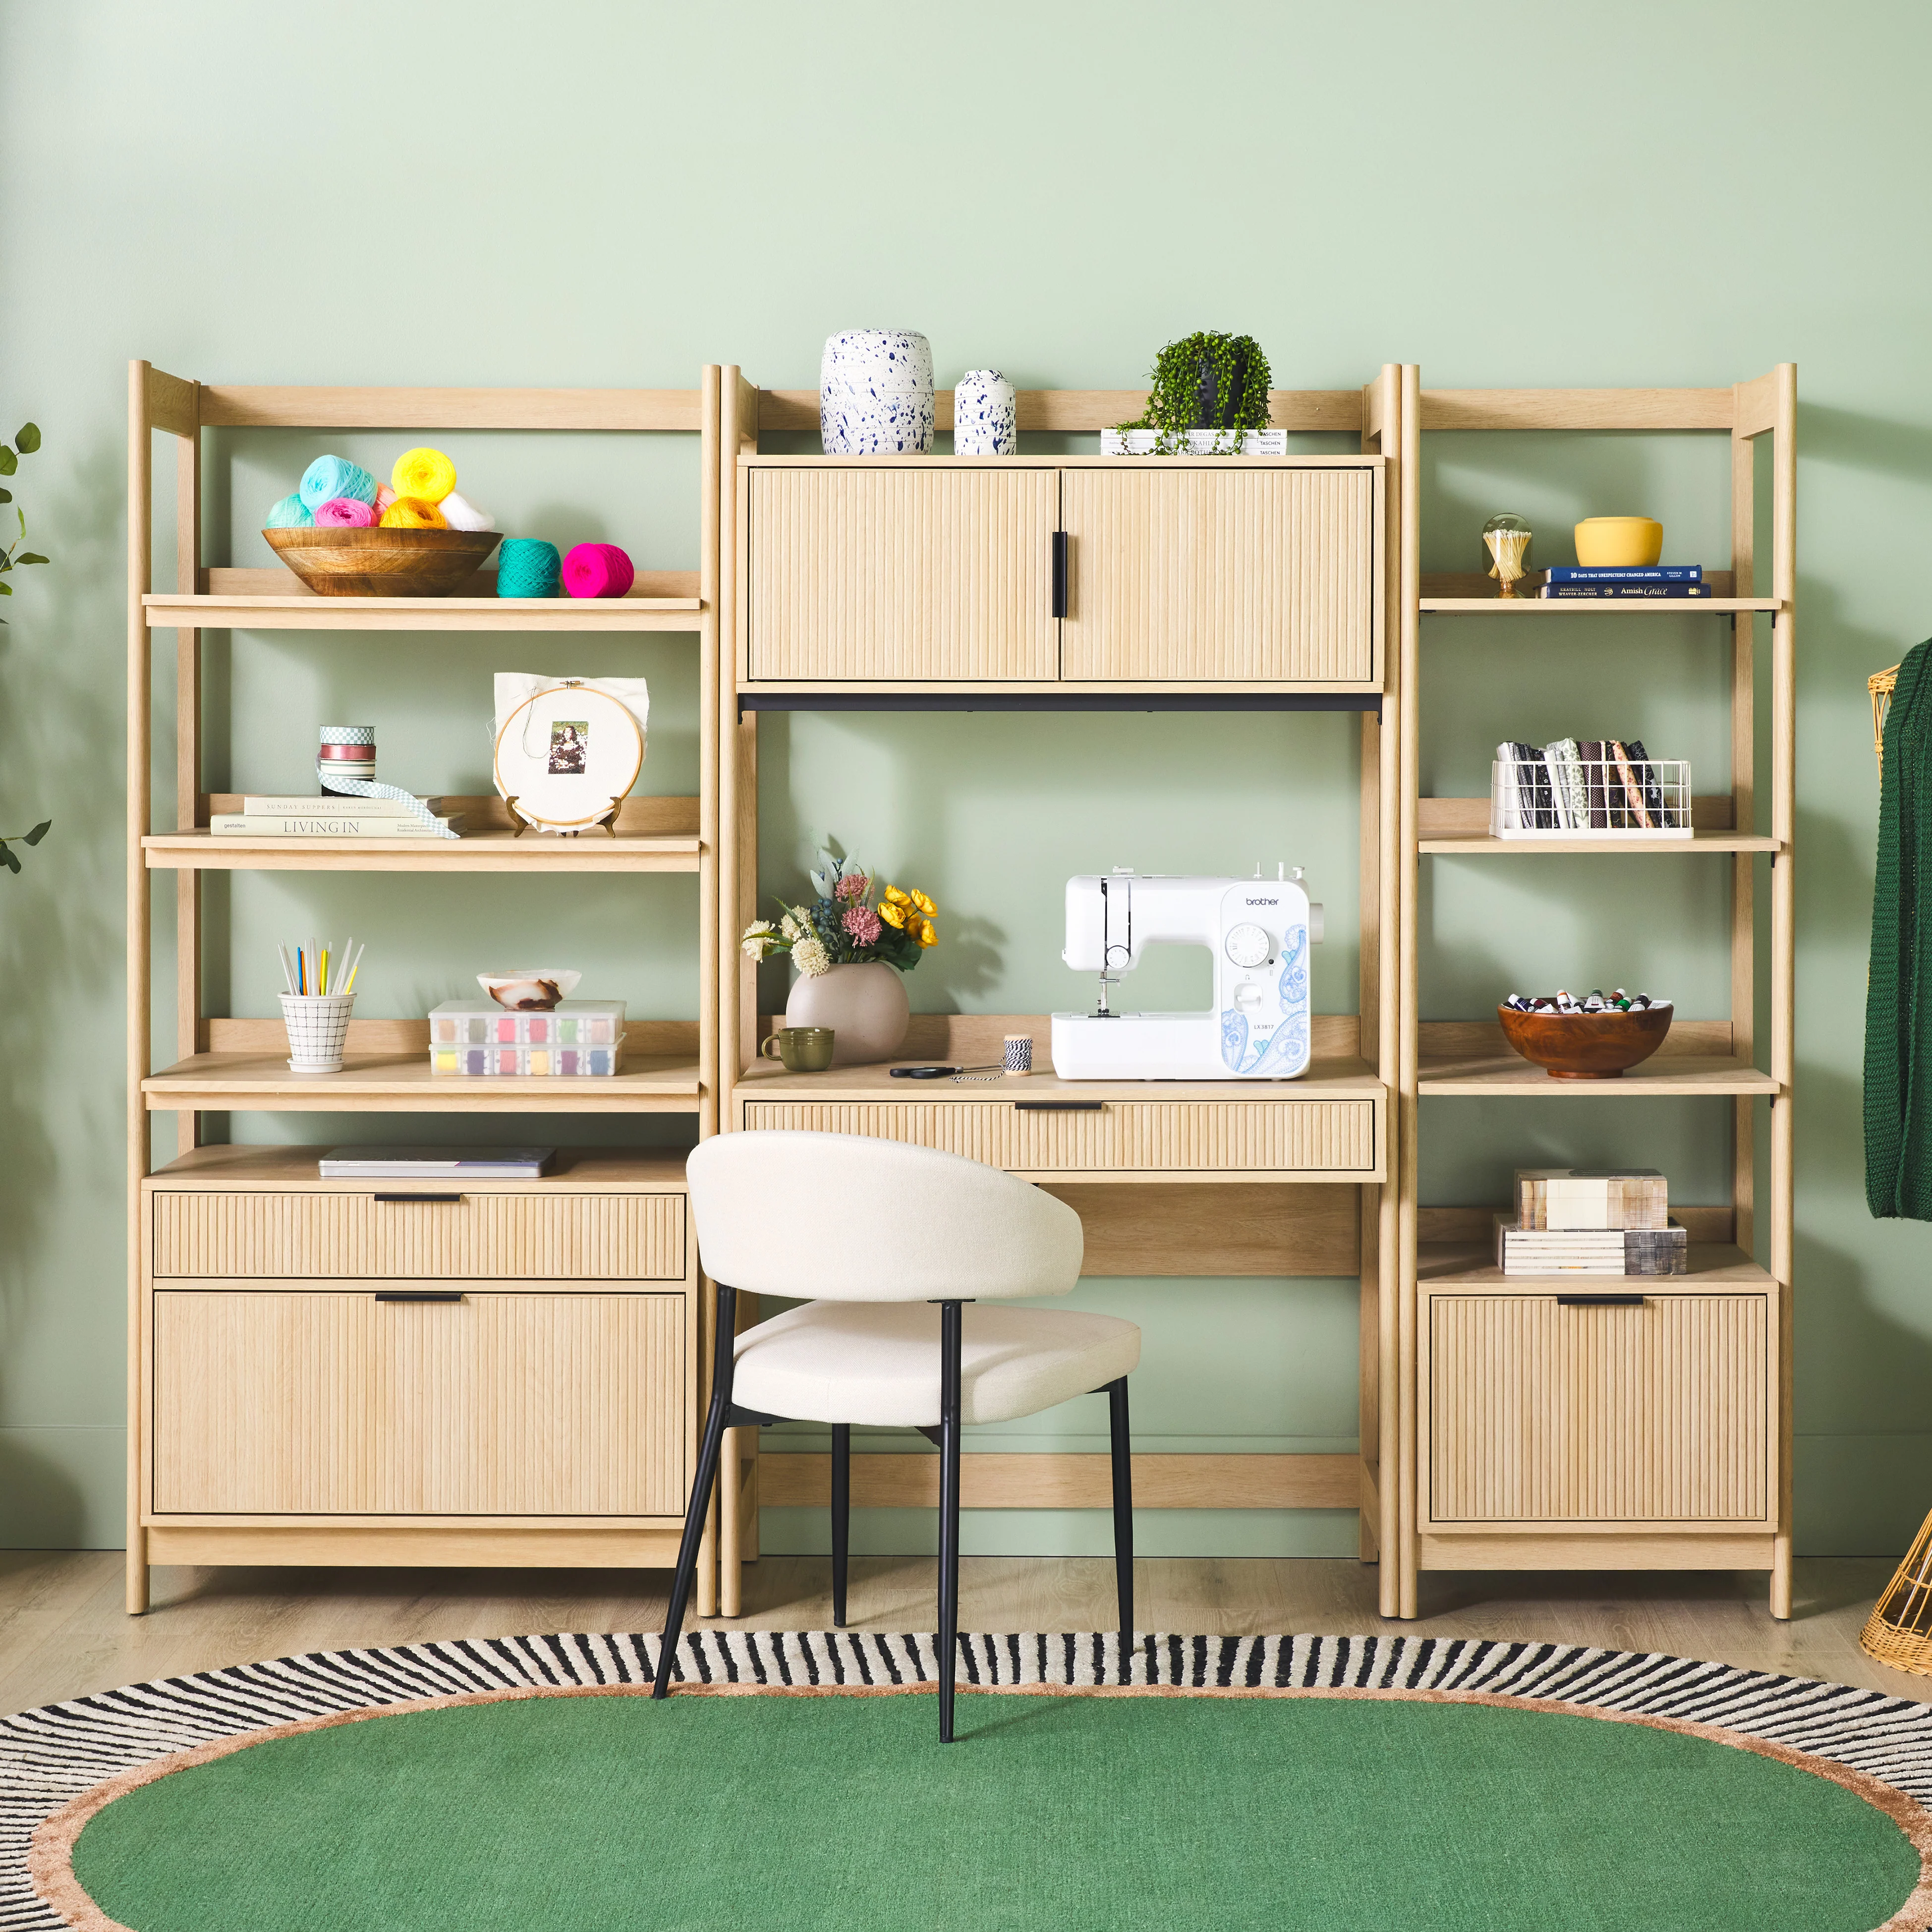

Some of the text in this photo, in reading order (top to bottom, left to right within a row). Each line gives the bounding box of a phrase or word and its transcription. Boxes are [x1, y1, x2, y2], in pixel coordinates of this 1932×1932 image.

[1644, 586, 1668, 598] Grace
[284, 821, 359, 833] LIVING IN
